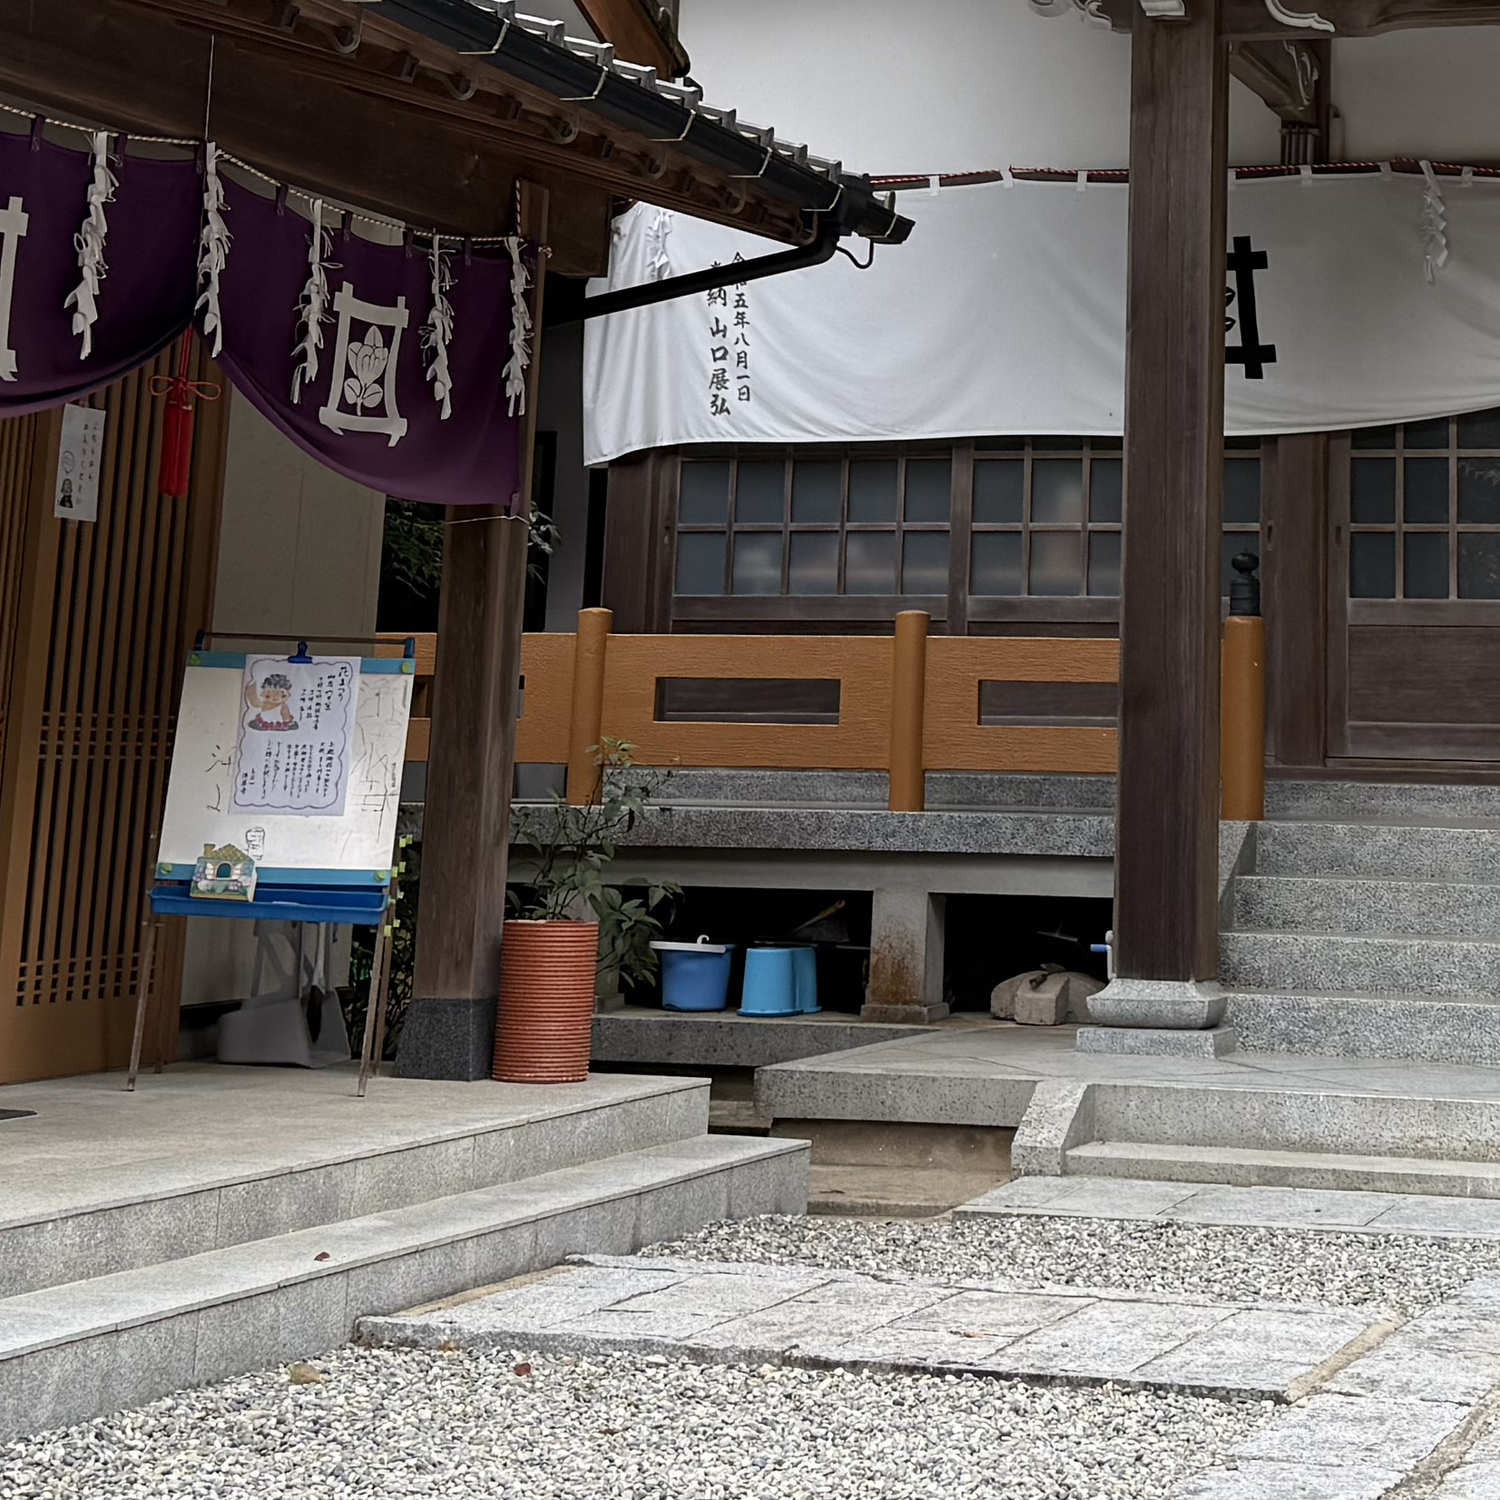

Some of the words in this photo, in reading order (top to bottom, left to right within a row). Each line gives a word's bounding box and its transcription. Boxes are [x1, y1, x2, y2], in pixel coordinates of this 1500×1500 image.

[707, 261, 731, 416] 納山口展弘
